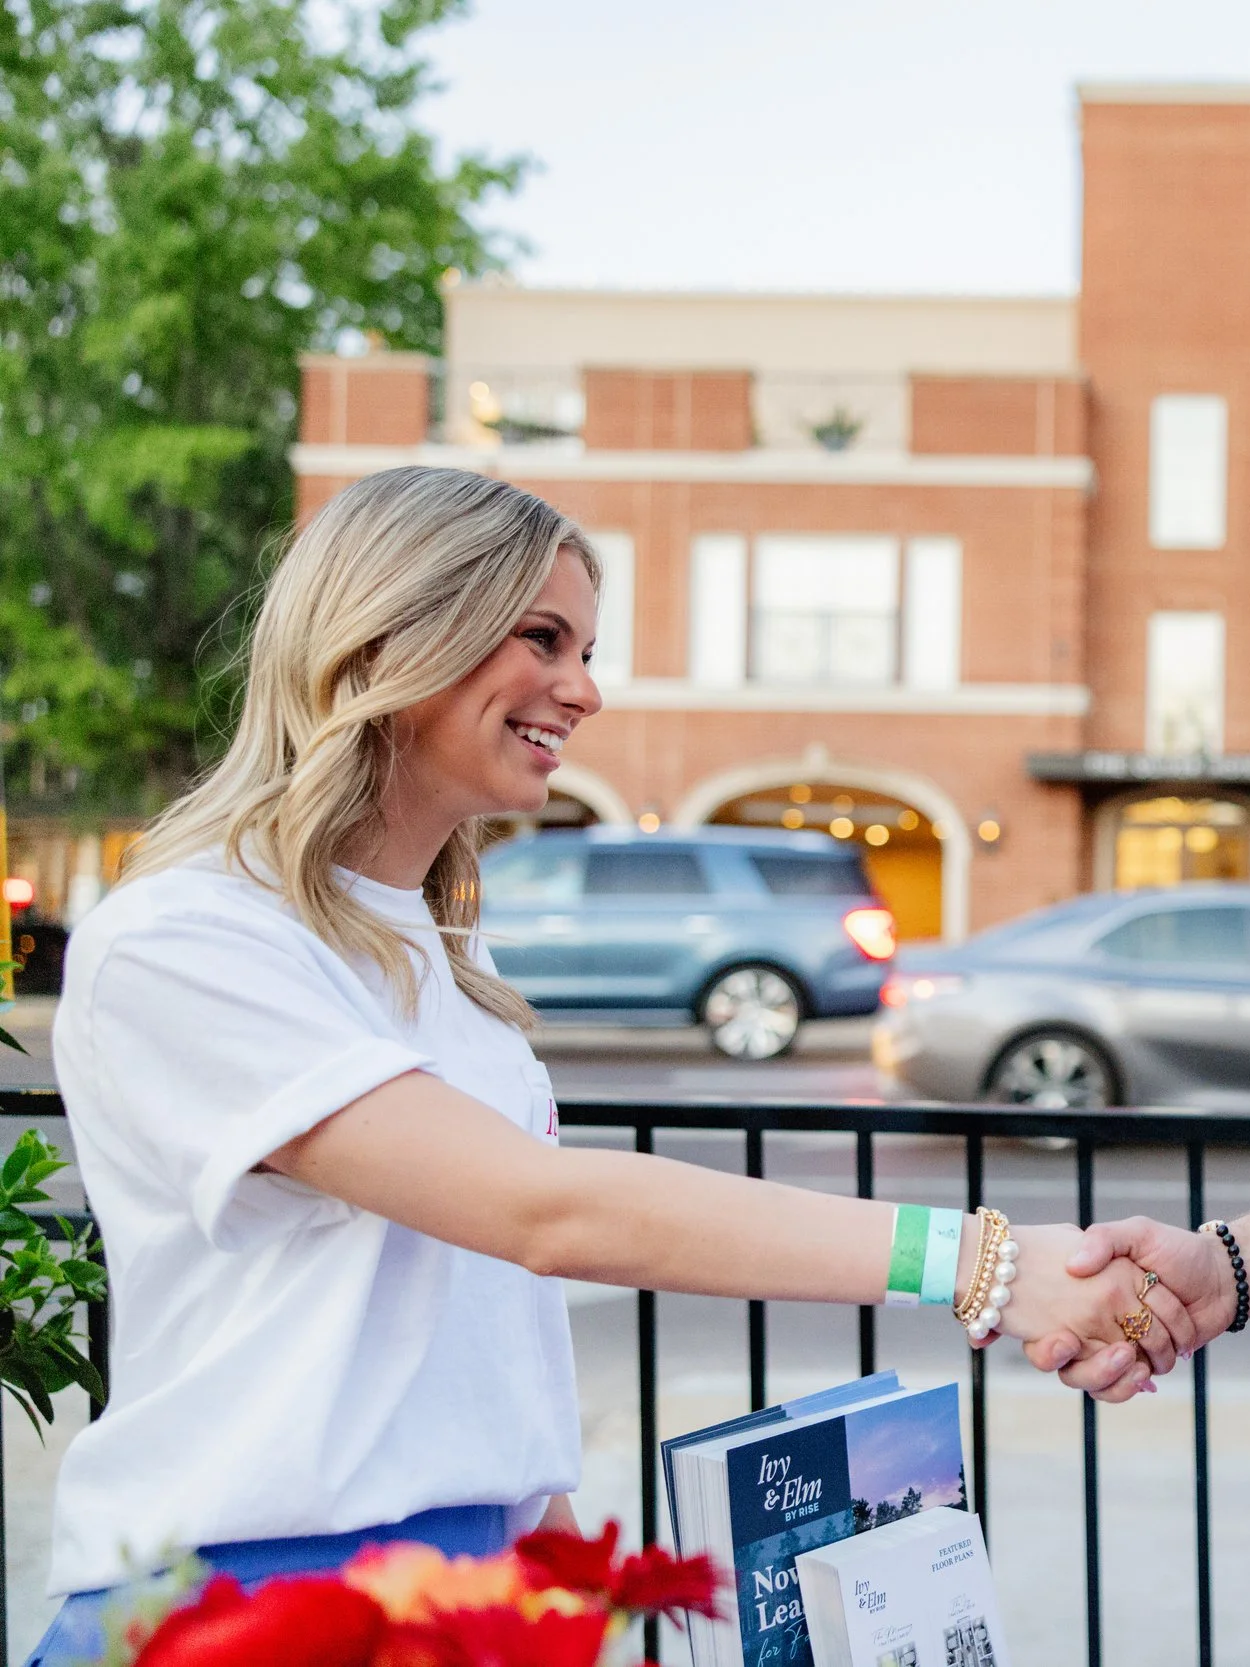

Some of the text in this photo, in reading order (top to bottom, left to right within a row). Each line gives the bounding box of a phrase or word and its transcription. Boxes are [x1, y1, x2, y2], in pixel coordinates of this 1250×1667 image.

[757, 1454, 791, 1487] Ivy
[764, 1475, 822, 1511] & Elm
[785, 1502, 820, 1522] BY RISE
[939, 1538, 972, 1557] FEATURED
[931, 1549, 974, 1573] FLOOR PLANS
[855, 1580, 870, 1596] Ivy
[859, 1591, 886, 1609] & Elm
[756, 1600, 806, 1632] Lea
[757, 1637, 781, 1667] for
